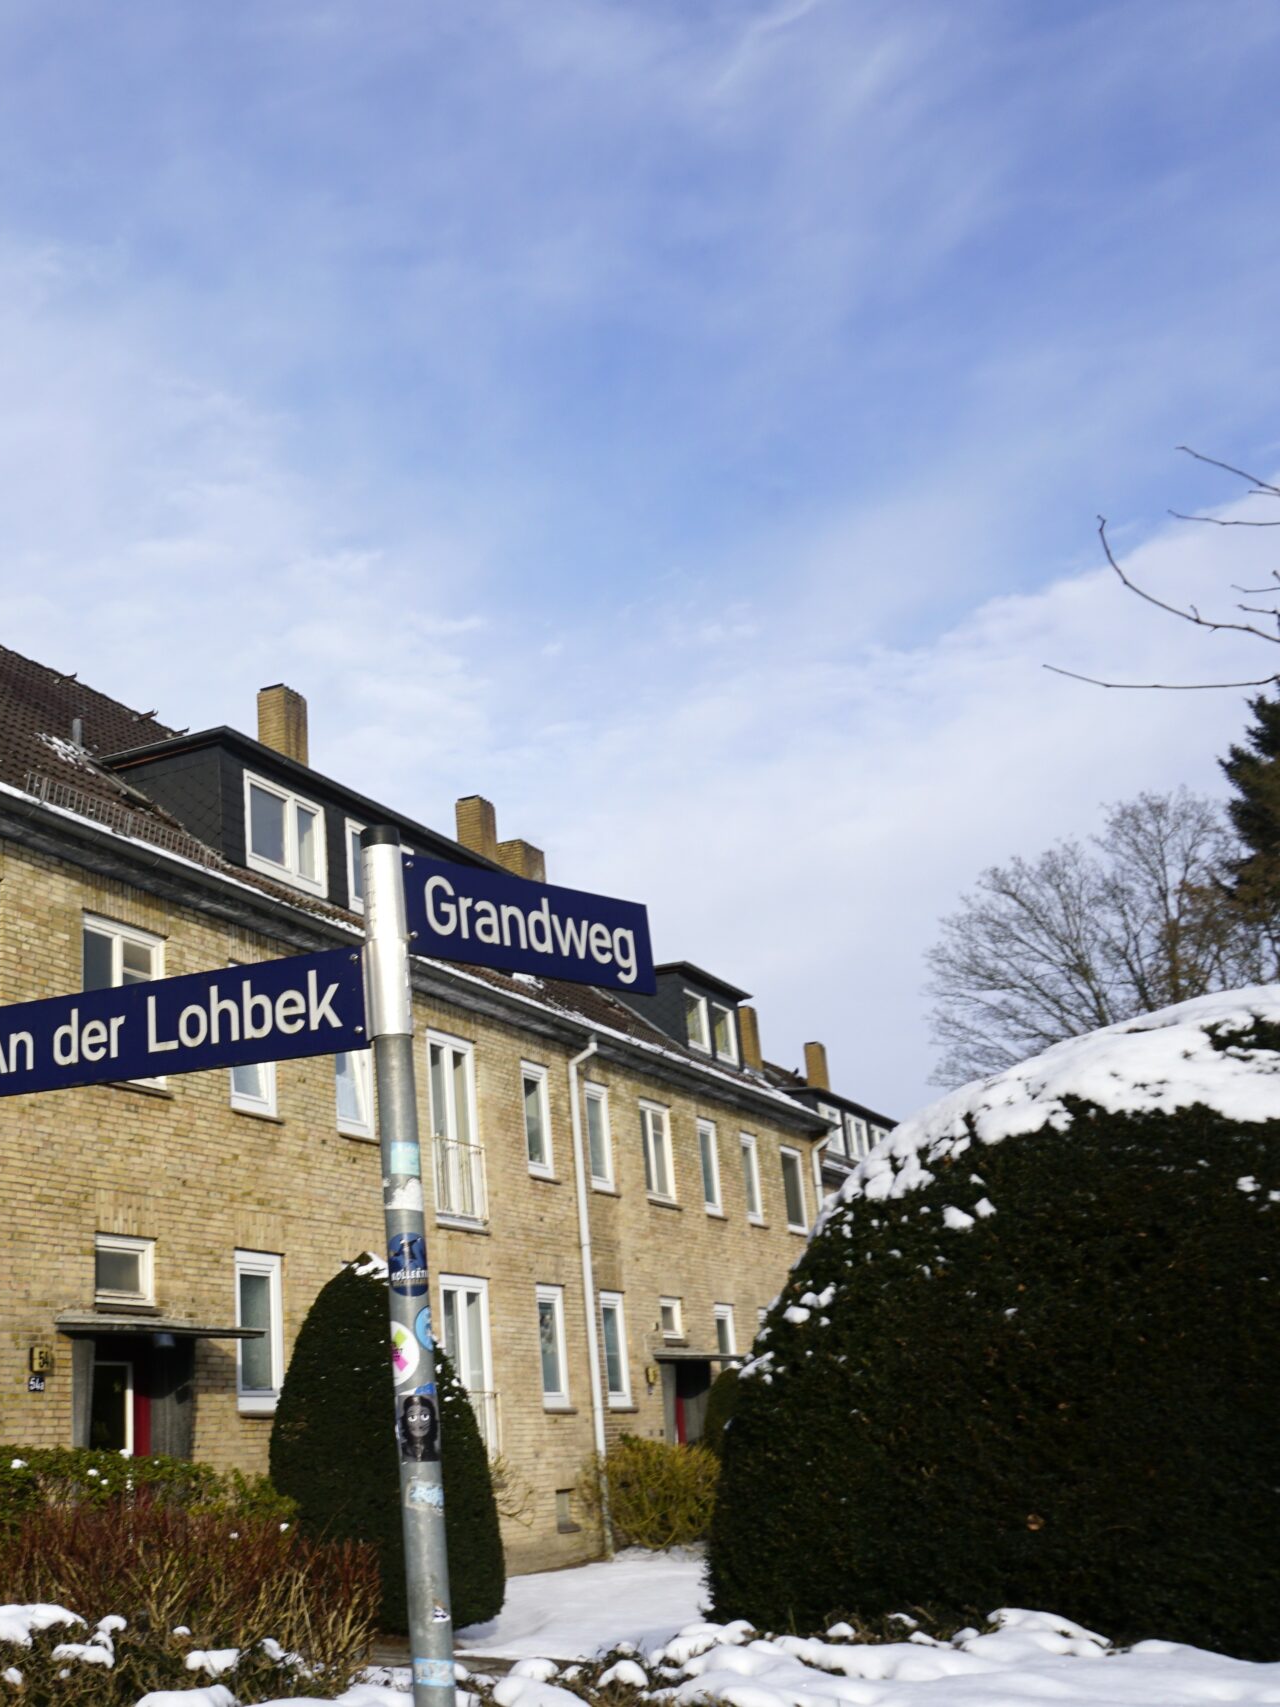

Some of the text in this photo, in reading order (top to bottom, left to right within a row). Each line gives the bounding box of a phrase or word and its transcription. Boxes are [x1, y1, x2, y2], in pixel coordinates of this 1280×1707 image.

[425, 876, 637, 983] Grandweg
[52, 1008, 125, 1065] der
[148, 970, 343, 1052] Lohbek
